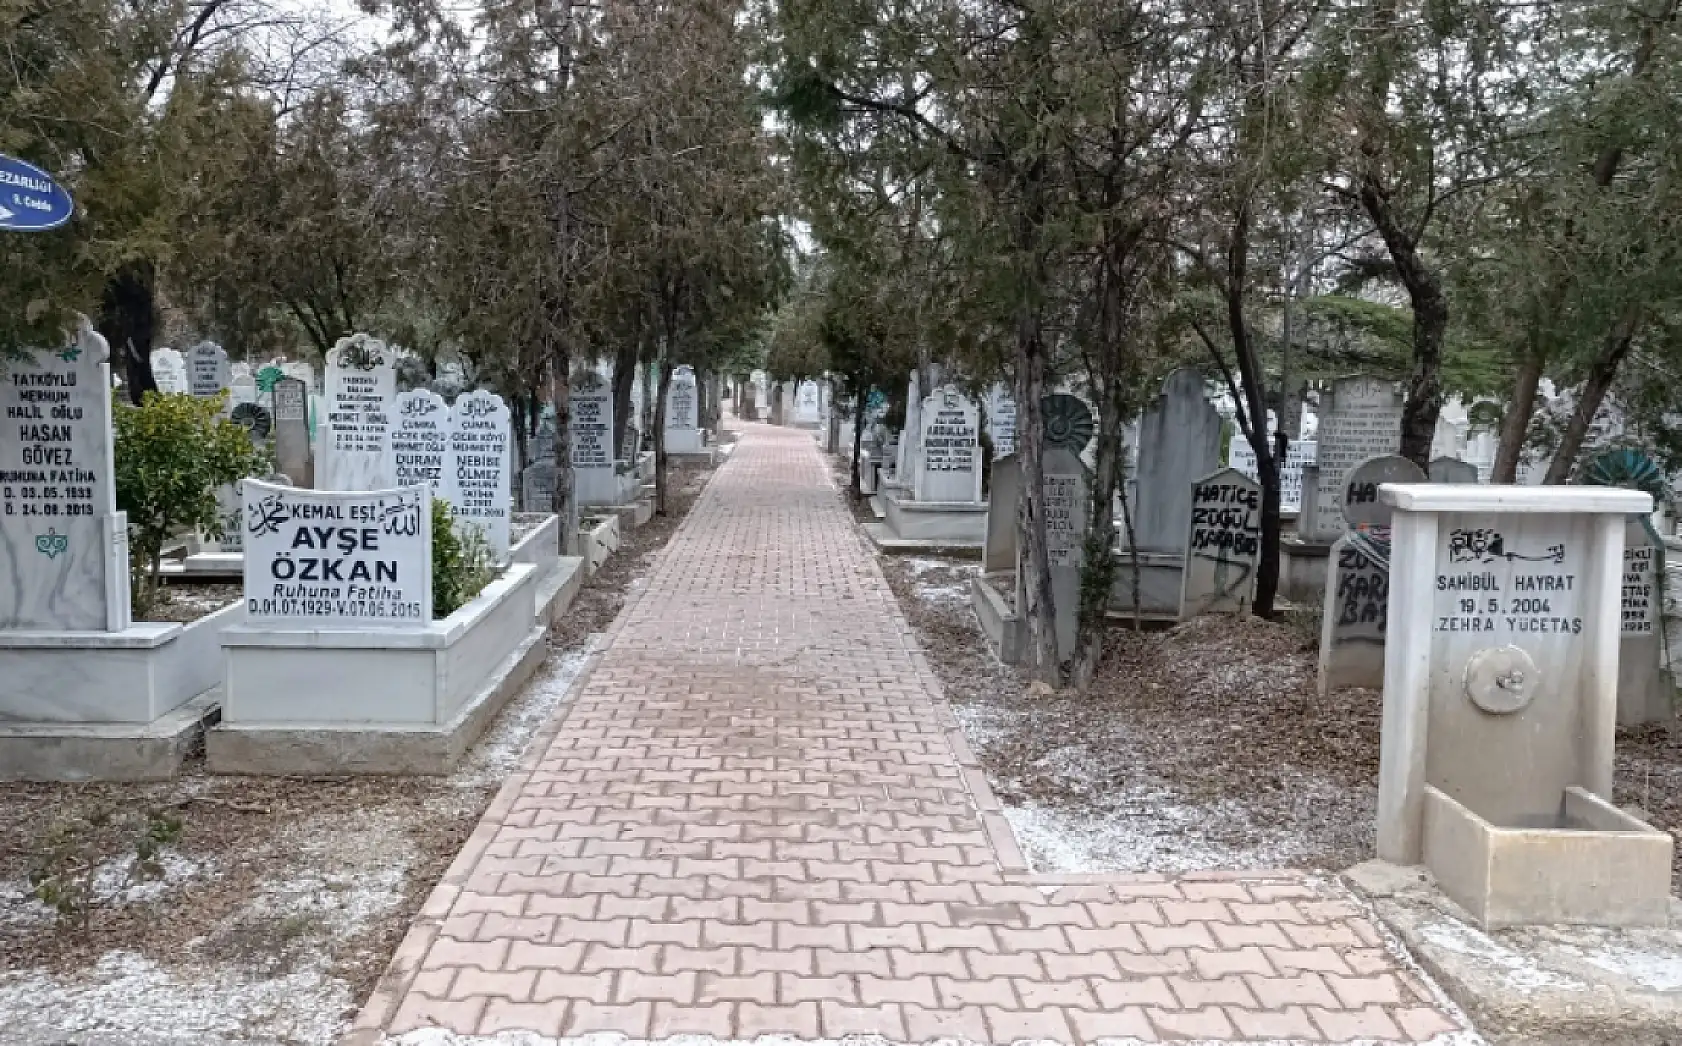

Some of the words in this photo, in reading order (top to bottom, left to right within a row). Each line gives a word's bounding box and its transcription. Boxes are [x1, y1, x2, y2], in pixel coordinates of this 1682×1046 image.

[12, 371, 77, 387] TATKÖYLÜ
[19, 389, 71, 403] MERHUM
[7, 405, 43, 419] HALİL
[50, 404, 83, 420] OĞLU
[20, 423, 72, 442] HASAN
[22, 444, 72, 466] GÖVEZ
[396, 453, 442, 466] DURAN
[396, 465, 442, 480] ÖLMEZ
[456, 466, 501, 480] ÖLMEZ
[1346, 483, 1376, 505] HA
[291, 503, 344, 520] KEMAL
[291, 526, 379, 556] AYŞE
[270, 551, 398, 583] ÖZKAN
[1337, 572, 1388, 602] KAR
[1437, 572, 1500, 591] SAHİBÜL
[1515, 575, 1575, 591] HAYRAT
[273, 583, 341, 599] Ruhuna
[347, 585, 402, 600] Fatiha
